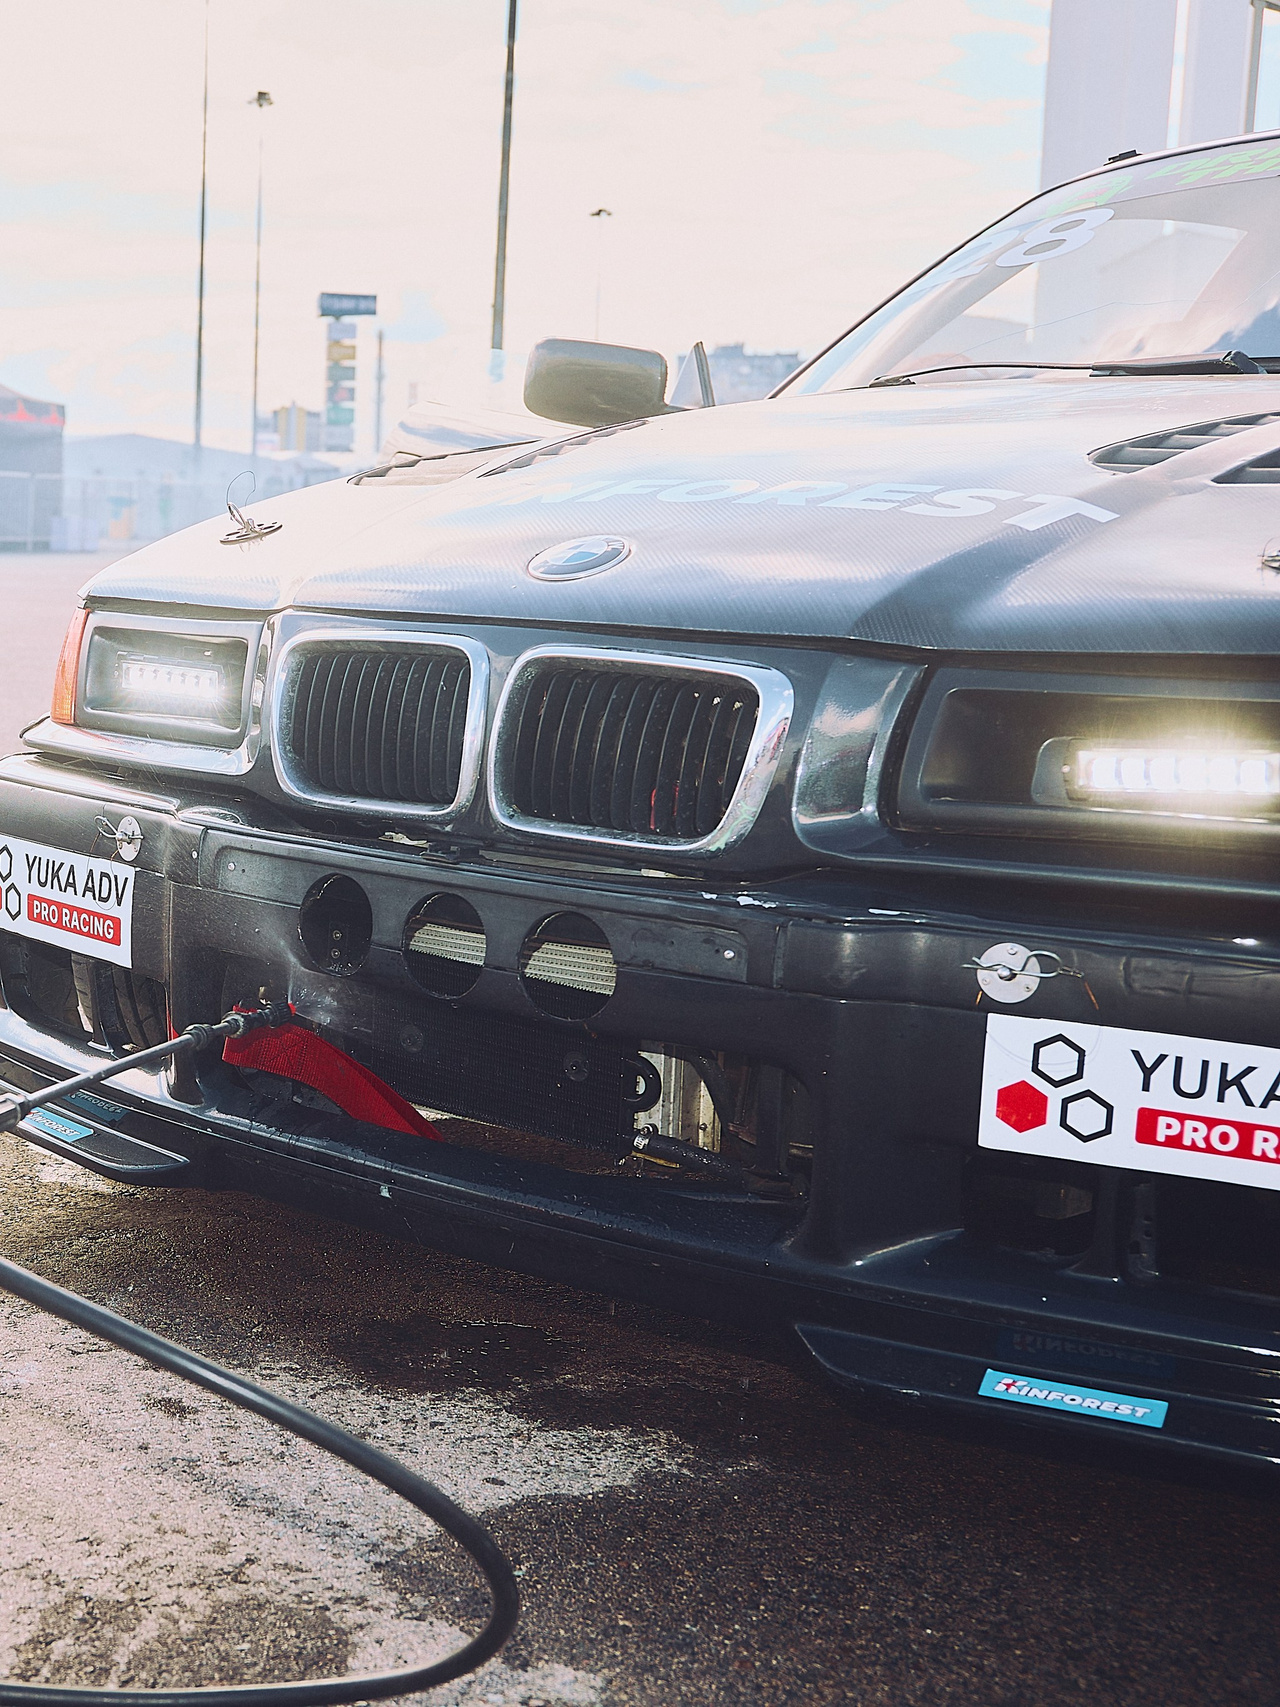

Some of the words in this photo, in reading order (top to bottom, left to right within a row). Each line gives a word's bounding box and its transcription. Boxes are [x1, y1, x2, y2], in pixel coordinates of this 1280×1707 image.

[907, 208, 1115, 298] 28
[496, 478, 1121, 532] NFOREST
[25, 853, 78, 896] YUKA
[81, 868, 129, 907] ADV
[33, 899, 59, 924] PRO
[62, 907, 115, 940] RACING
[1156, 1115, 1240, 1152] PRO
[1252, 1129, 1280, 1160] R
[993, 1377, 1152, 1418] KINFOREST
